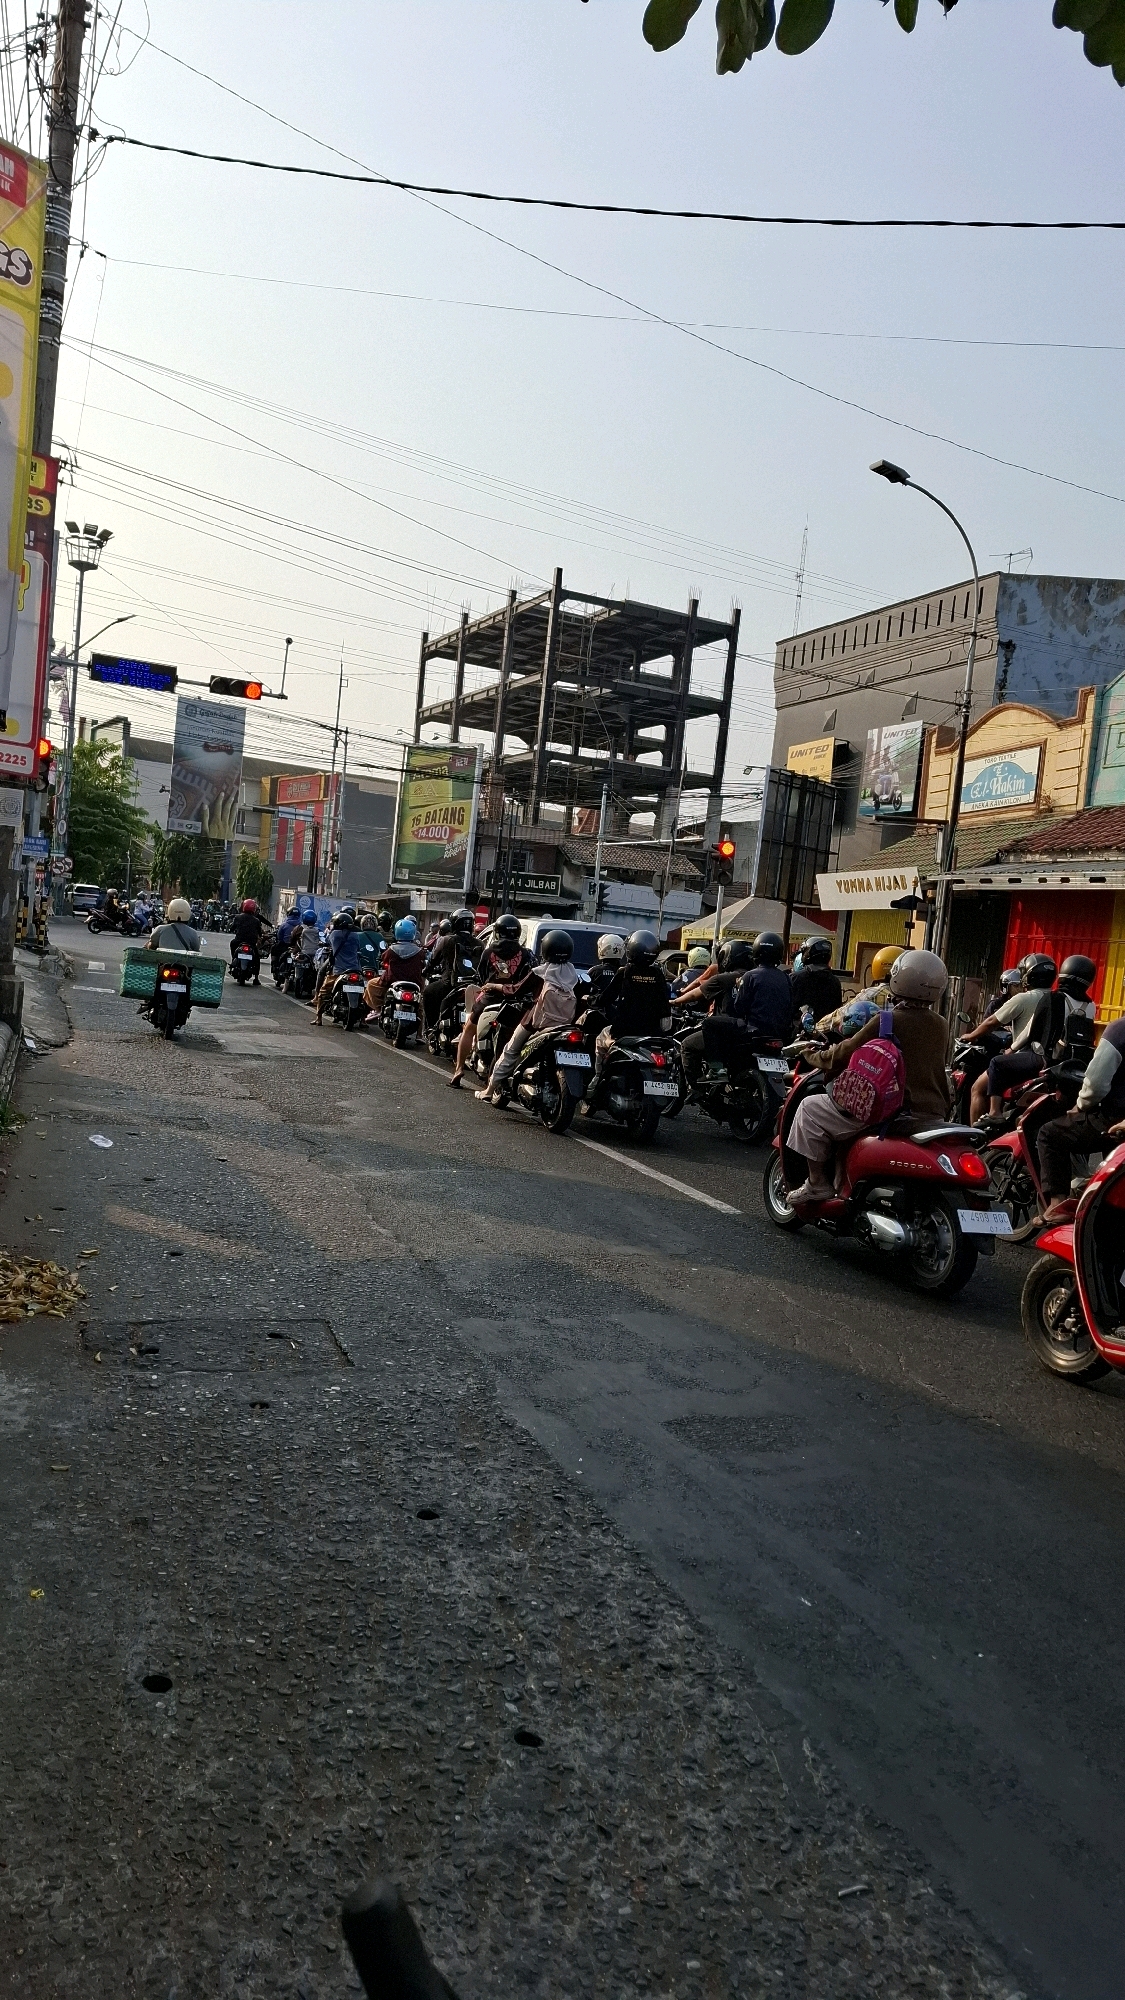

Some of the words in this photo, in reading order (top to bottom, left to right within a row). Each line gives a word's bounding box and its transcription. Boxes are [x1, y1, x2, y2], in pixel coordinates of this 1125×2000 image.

[790, 744, 830, 758] UNITED
[411, 814, 422, 828] 16
[424, 806, 466, 825] BATANG
[417, 825, 450, 840] 14.000
[524, 879, 557, 890] JILBAB
[835, 877, 874, 894] YUMNA
[874, 874, 908, 892] HIJAB
[960, 1211, 967, 1222] K
